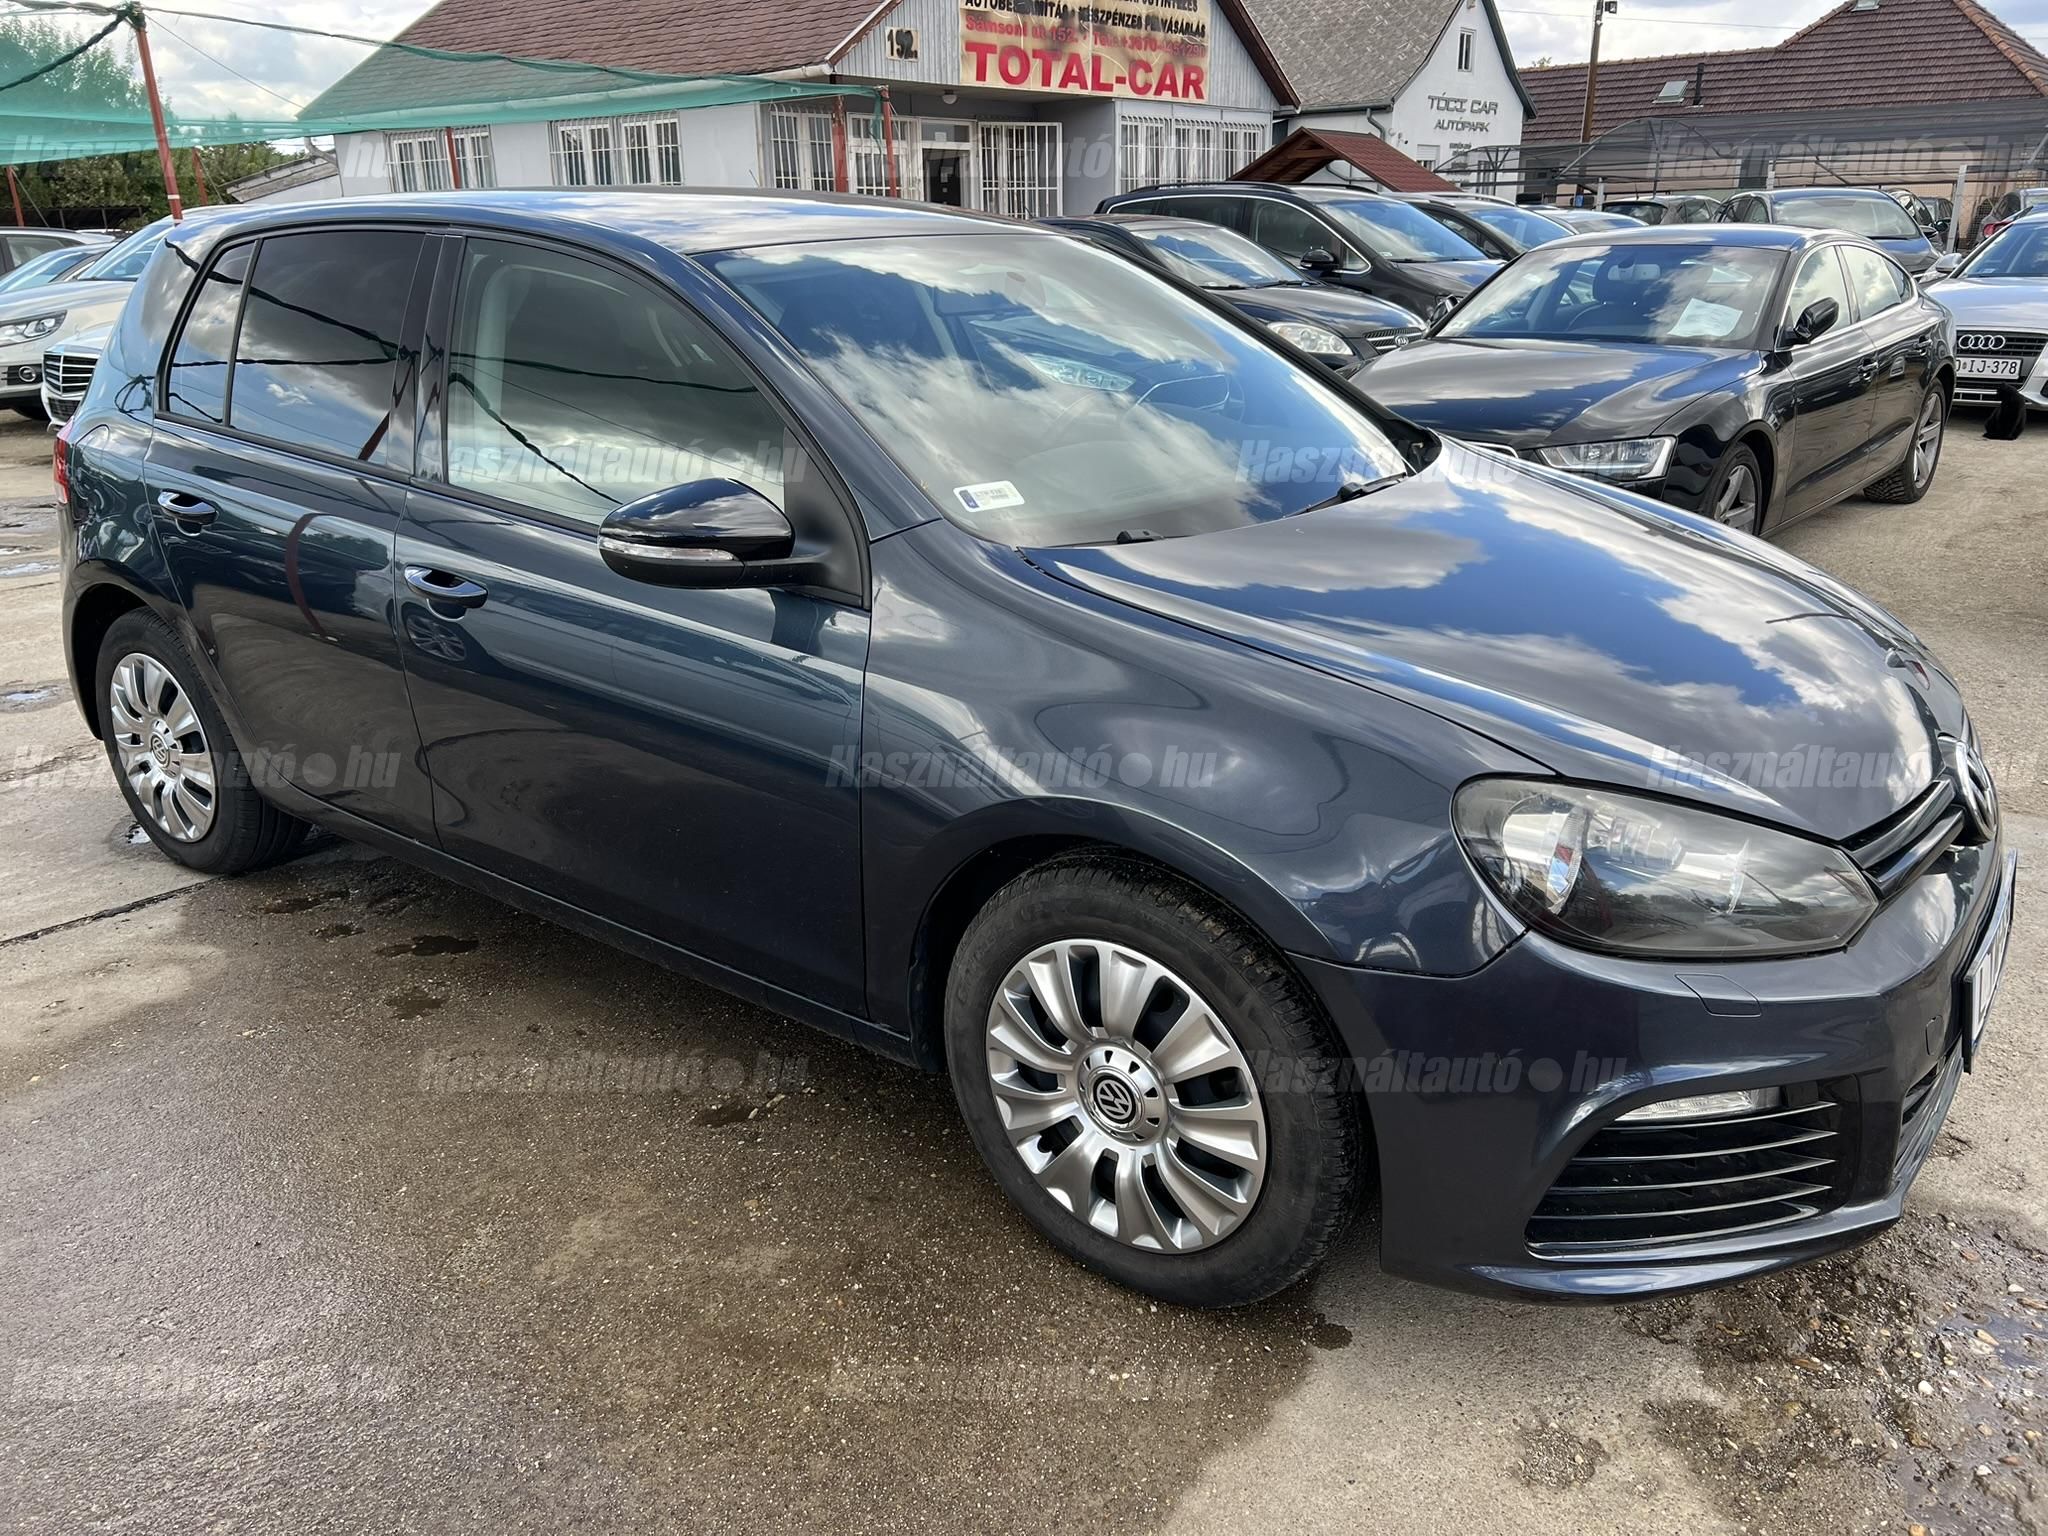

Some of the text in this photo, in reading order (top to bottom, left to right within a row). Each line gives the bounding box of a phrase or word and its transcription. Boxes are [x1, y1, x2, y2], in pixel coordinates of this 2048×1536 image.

[965, 42, 1204, 99] TOTAL-CAR
[1470, 99, 1499, 115] CAR
[1434, 116, 1490, 133] AUTÓPARK
